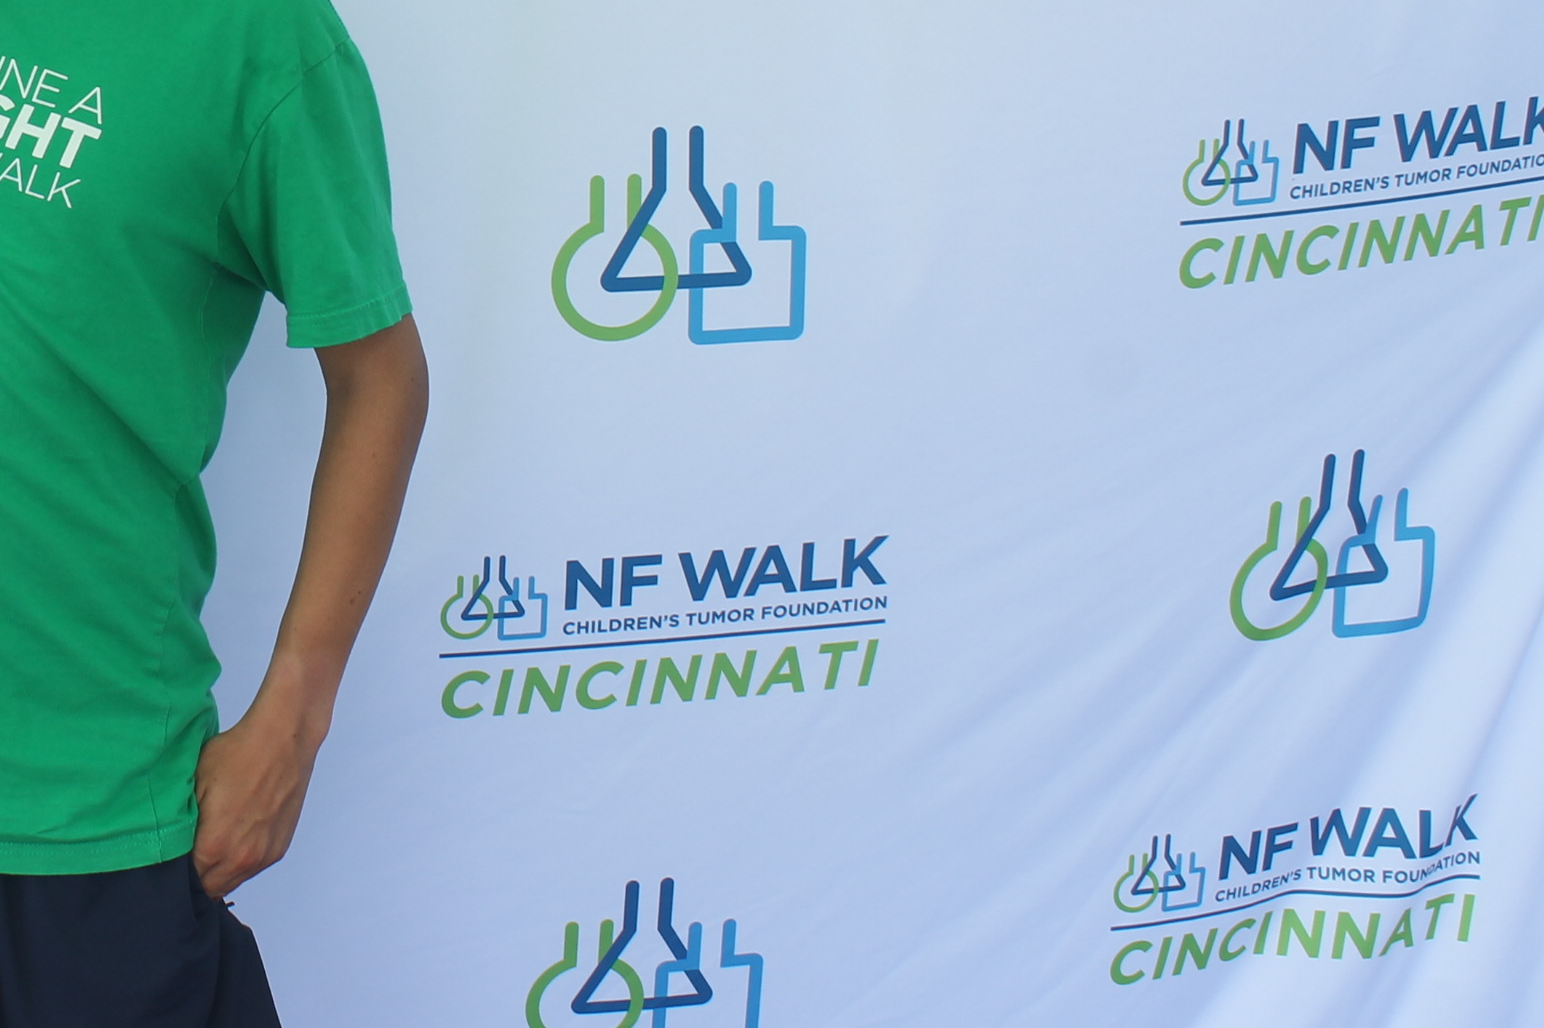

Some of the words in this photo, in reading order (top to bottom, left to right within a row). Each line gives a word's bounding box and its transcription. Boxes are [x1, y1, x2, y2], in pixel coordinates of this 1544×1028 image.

[68, 87, 102, 124] A
[1292, 116, 1381, 175] NF
[1289, 175, 1389, 200] CHILDREN'S
[1394, 168, 1451, 187] TUMOR
[1179, 194, 1544, 290] CINCINNATI
[564, 554, 663, 611] NF
[678, 535, 890, 602] WALK
[562, 613, 680, 636] CHILDREN'S
[686, 607, 755, 627] TUMOR
[761, 595, 888, 620] FOUNDATION
[440, 639, 879, 719] CINCINNATI
[1218, 822, 1299, 880] NF
[1309, 793, 1478, 859] WALK
[1215, 869, 1302, 903] CHILDREN'S
[1306, 866, 1376, 884] TUMOR
[1109, 893, 1476, 986] CINCINNATI
